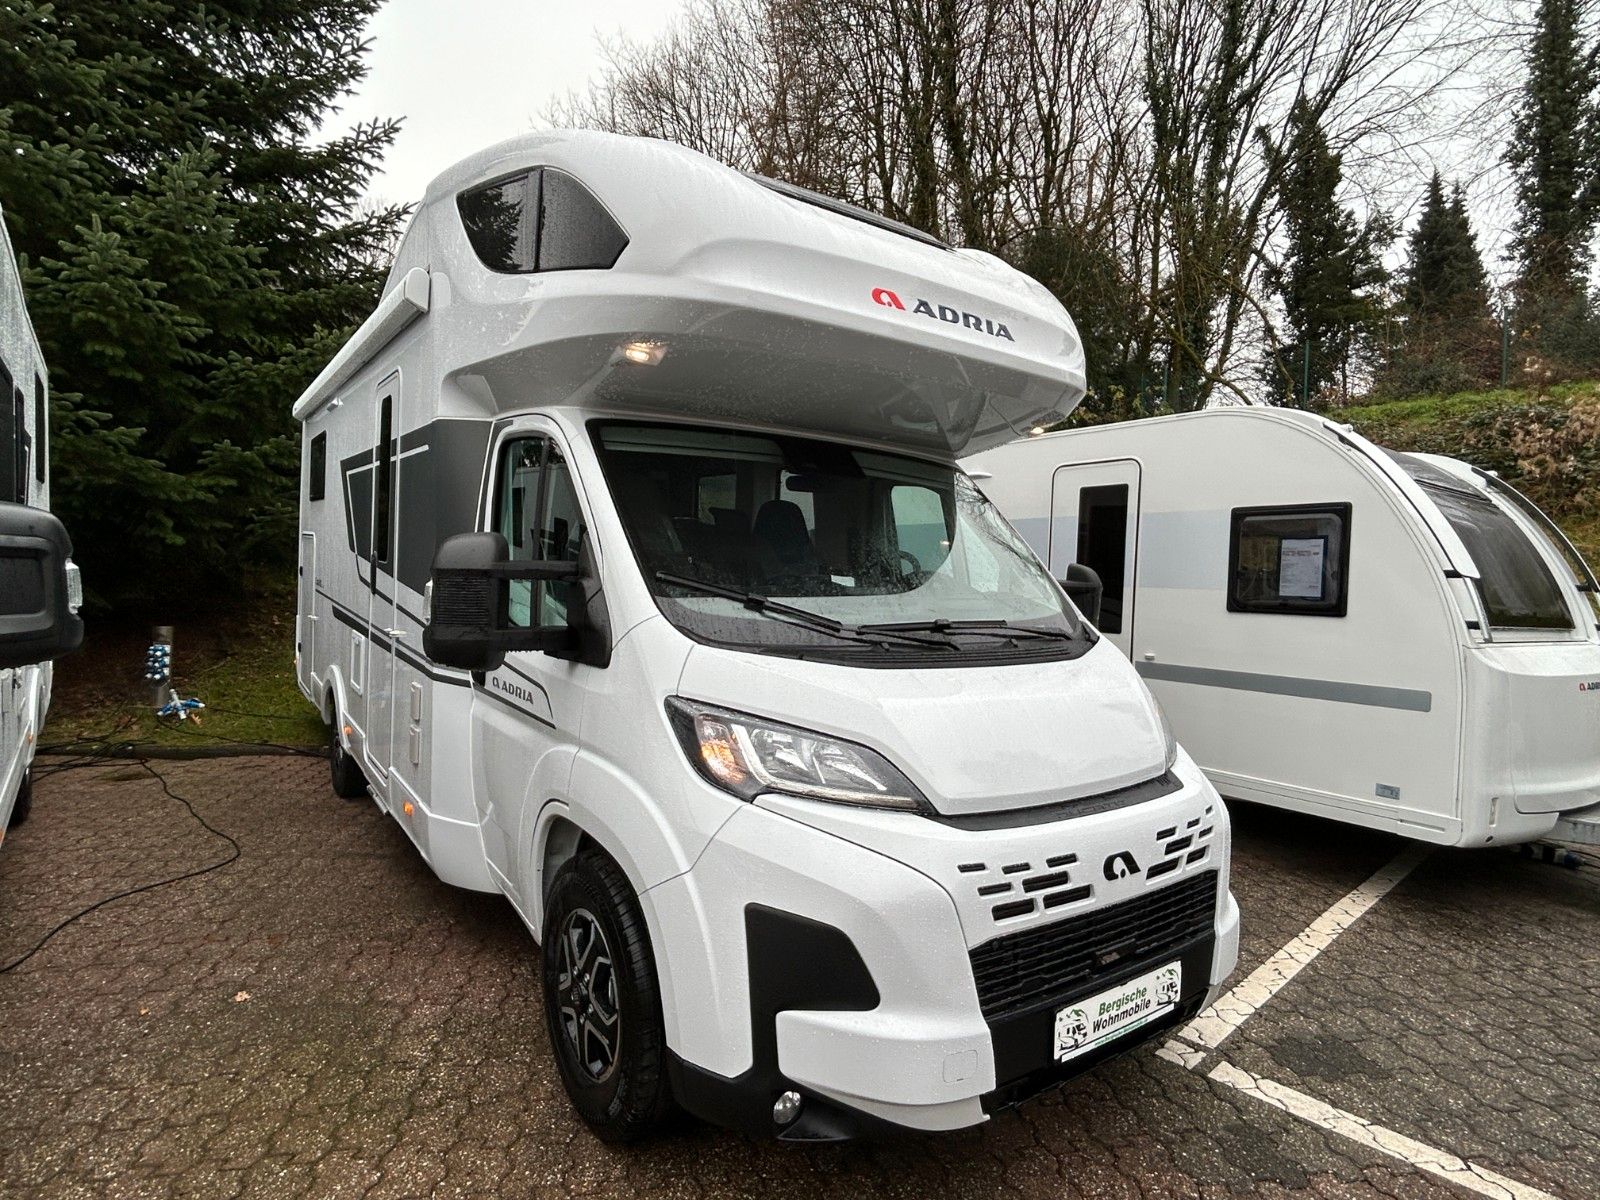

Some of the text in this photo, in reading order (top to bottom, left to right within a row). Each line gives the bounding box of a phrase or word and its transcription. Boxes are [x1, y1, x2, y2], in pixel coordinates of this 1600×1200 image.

[913, 298, 1015, 342] ADRIA
[501, 680, 534, 705] ADRIA
[1092, 999, 1151, 1033] Wohnmobile
[1098, 986, 1147, 1016] Bergische
